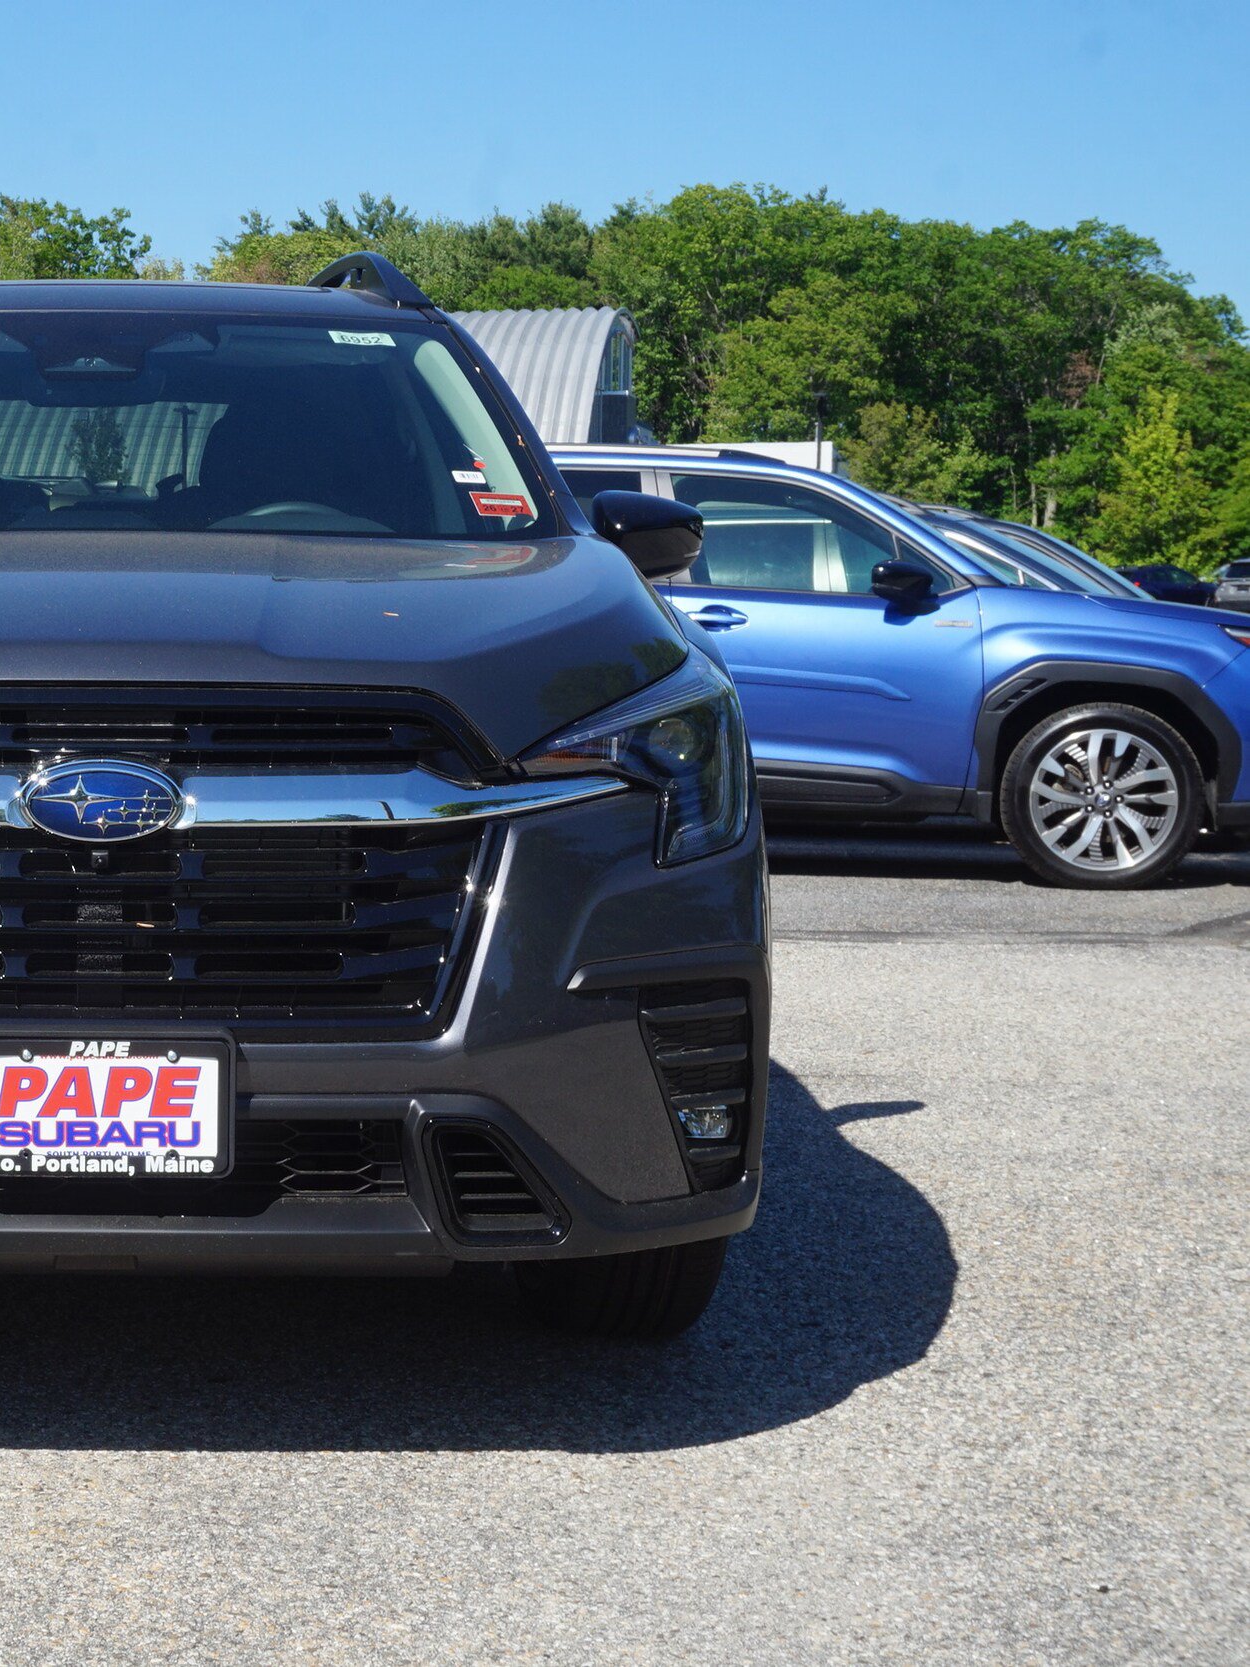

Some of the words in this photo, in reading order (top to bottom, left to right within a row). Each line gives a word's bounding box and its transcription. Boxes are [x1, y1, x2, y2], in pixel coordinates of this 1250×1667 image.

[69, 1041, 131, 1057] PAPE
[31, 1154, 136, 1176] Portland,
[145, 1155, 215, 1173] Maine
